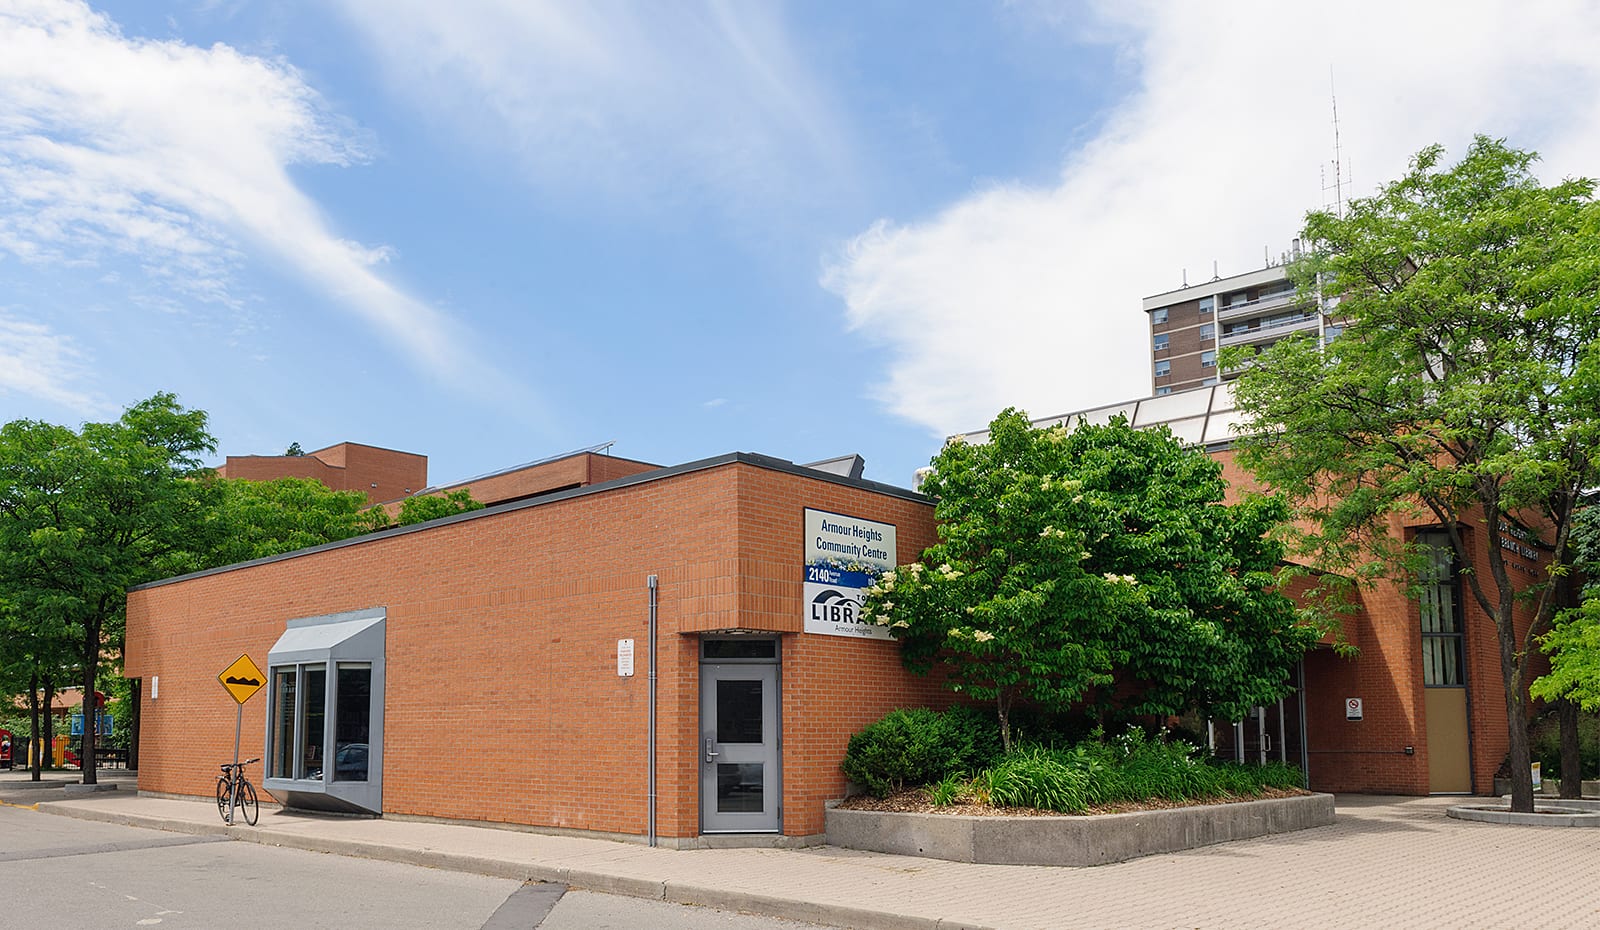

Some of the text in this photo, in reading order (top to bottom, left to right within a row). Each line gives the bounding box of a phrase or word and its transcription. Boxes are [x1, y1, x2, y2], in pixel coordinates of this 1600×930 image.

[821, 519, 883, 543] Armour Heights
[816, 536, 888, 560] Community Centre
[808, 567, 829, 583] 2140
